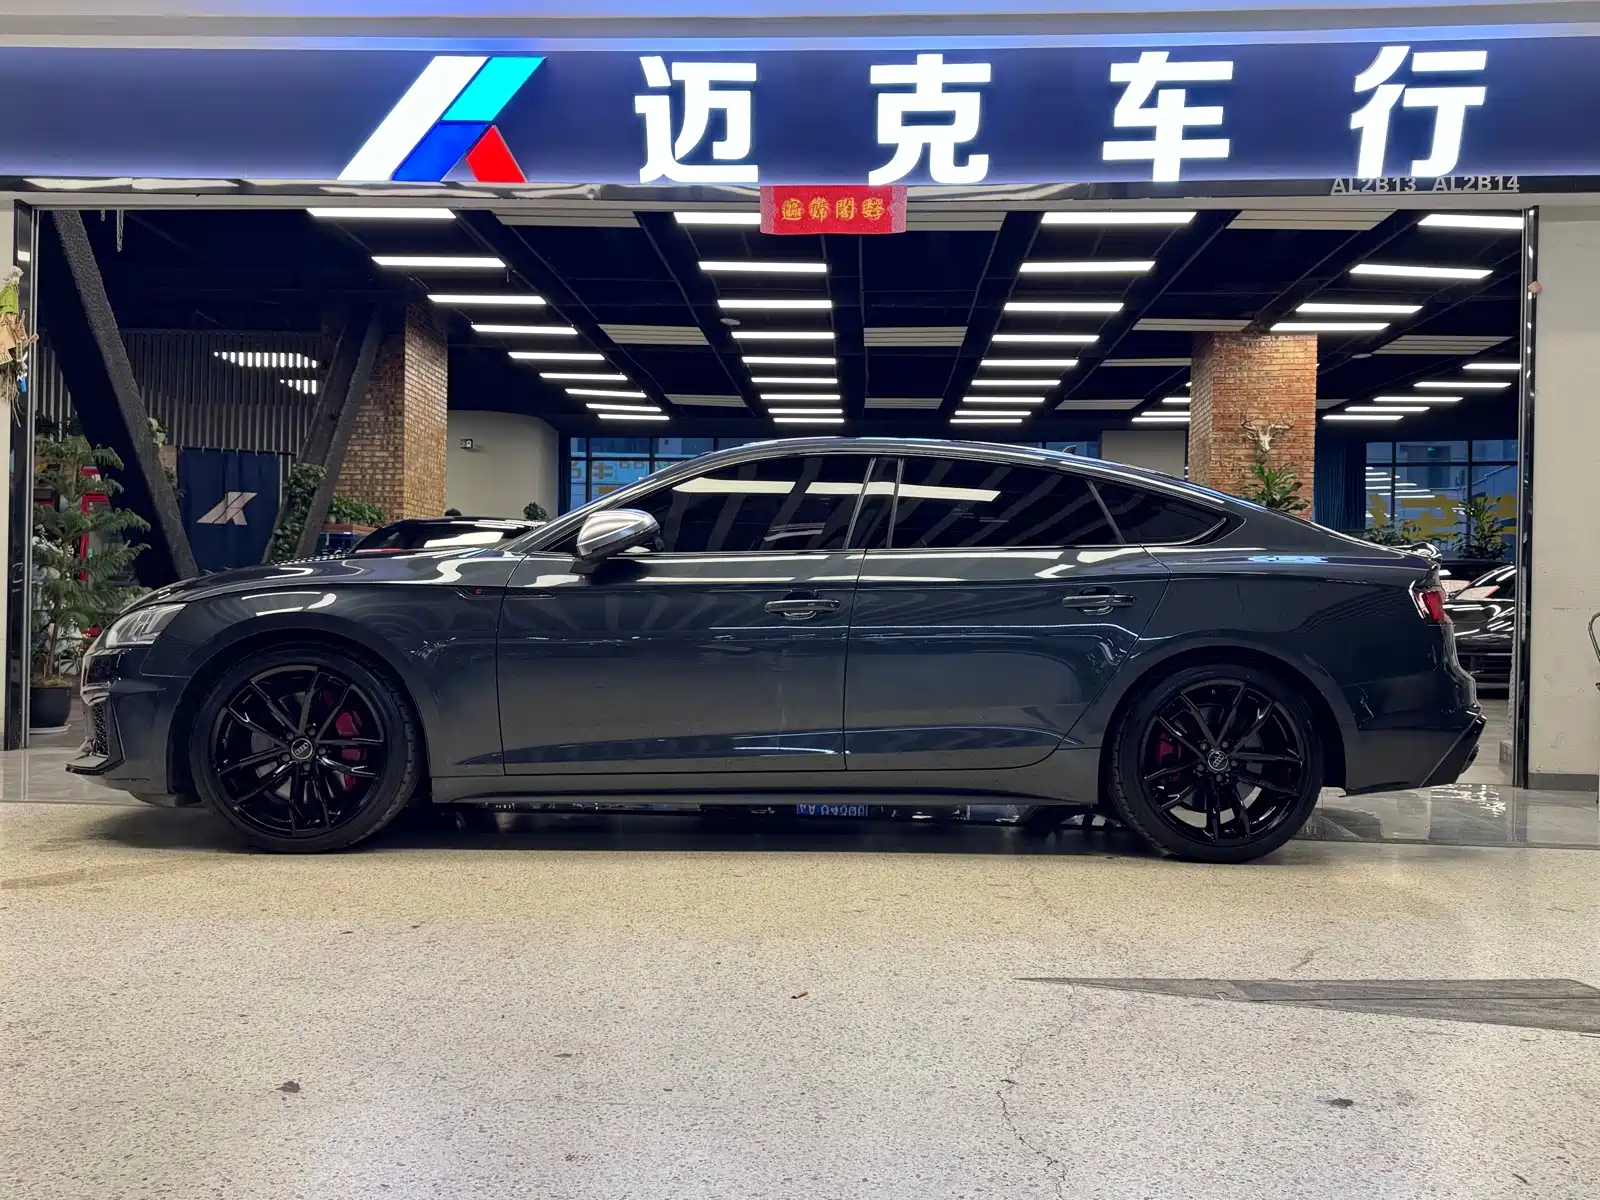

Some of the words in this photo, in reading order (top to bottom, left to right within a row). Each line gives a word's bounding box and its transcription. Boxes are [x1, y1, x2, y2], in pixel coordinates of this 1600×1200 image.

[635, 46, 1488, 185] 迈克车行
[1330, 176, 1417, 194] AL2B13
[1432, 175, 1520, 193] AL2B14
